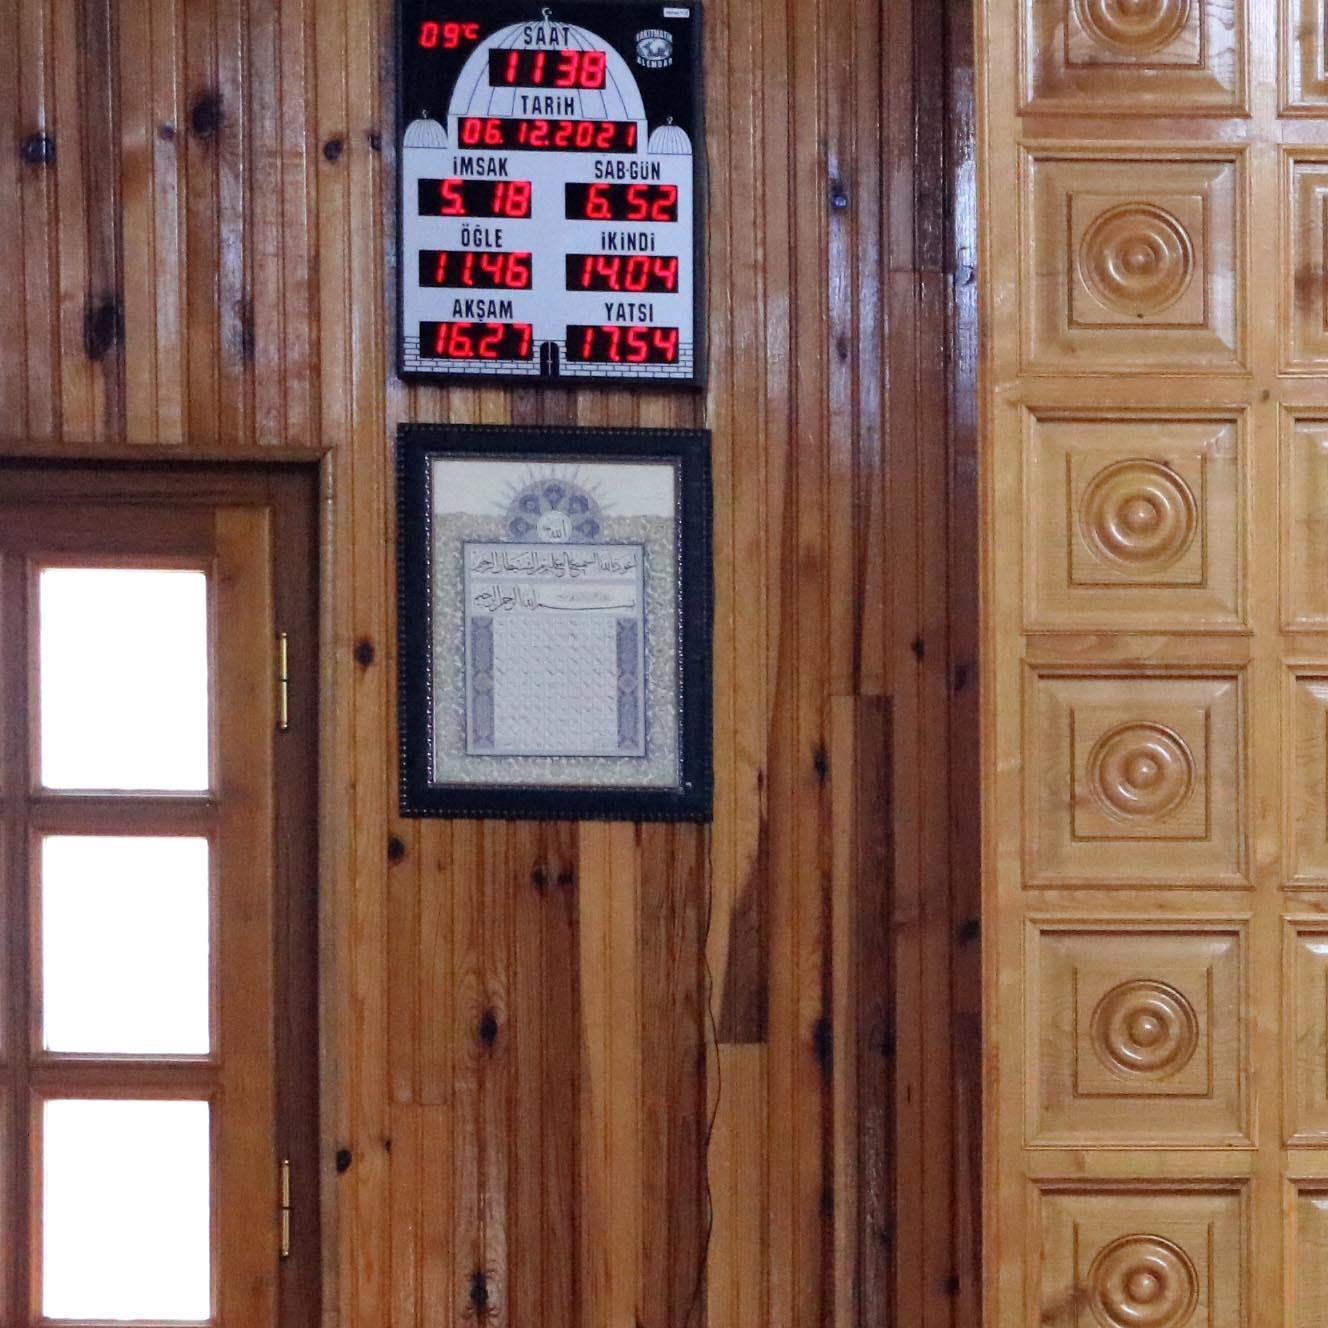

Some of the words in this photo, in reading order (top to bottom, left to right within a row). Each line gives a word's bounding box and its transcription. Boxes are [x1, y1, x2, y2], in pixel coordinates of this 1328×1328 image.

[524, 26, 570, 46] SAAT
[453, 156, 508, 176] İMSAK
[461, 223, 503, 248] ÖĞLE
[452, 298, 513, 321] AKŞAM
[605, 302, 653, 322] YATSI
